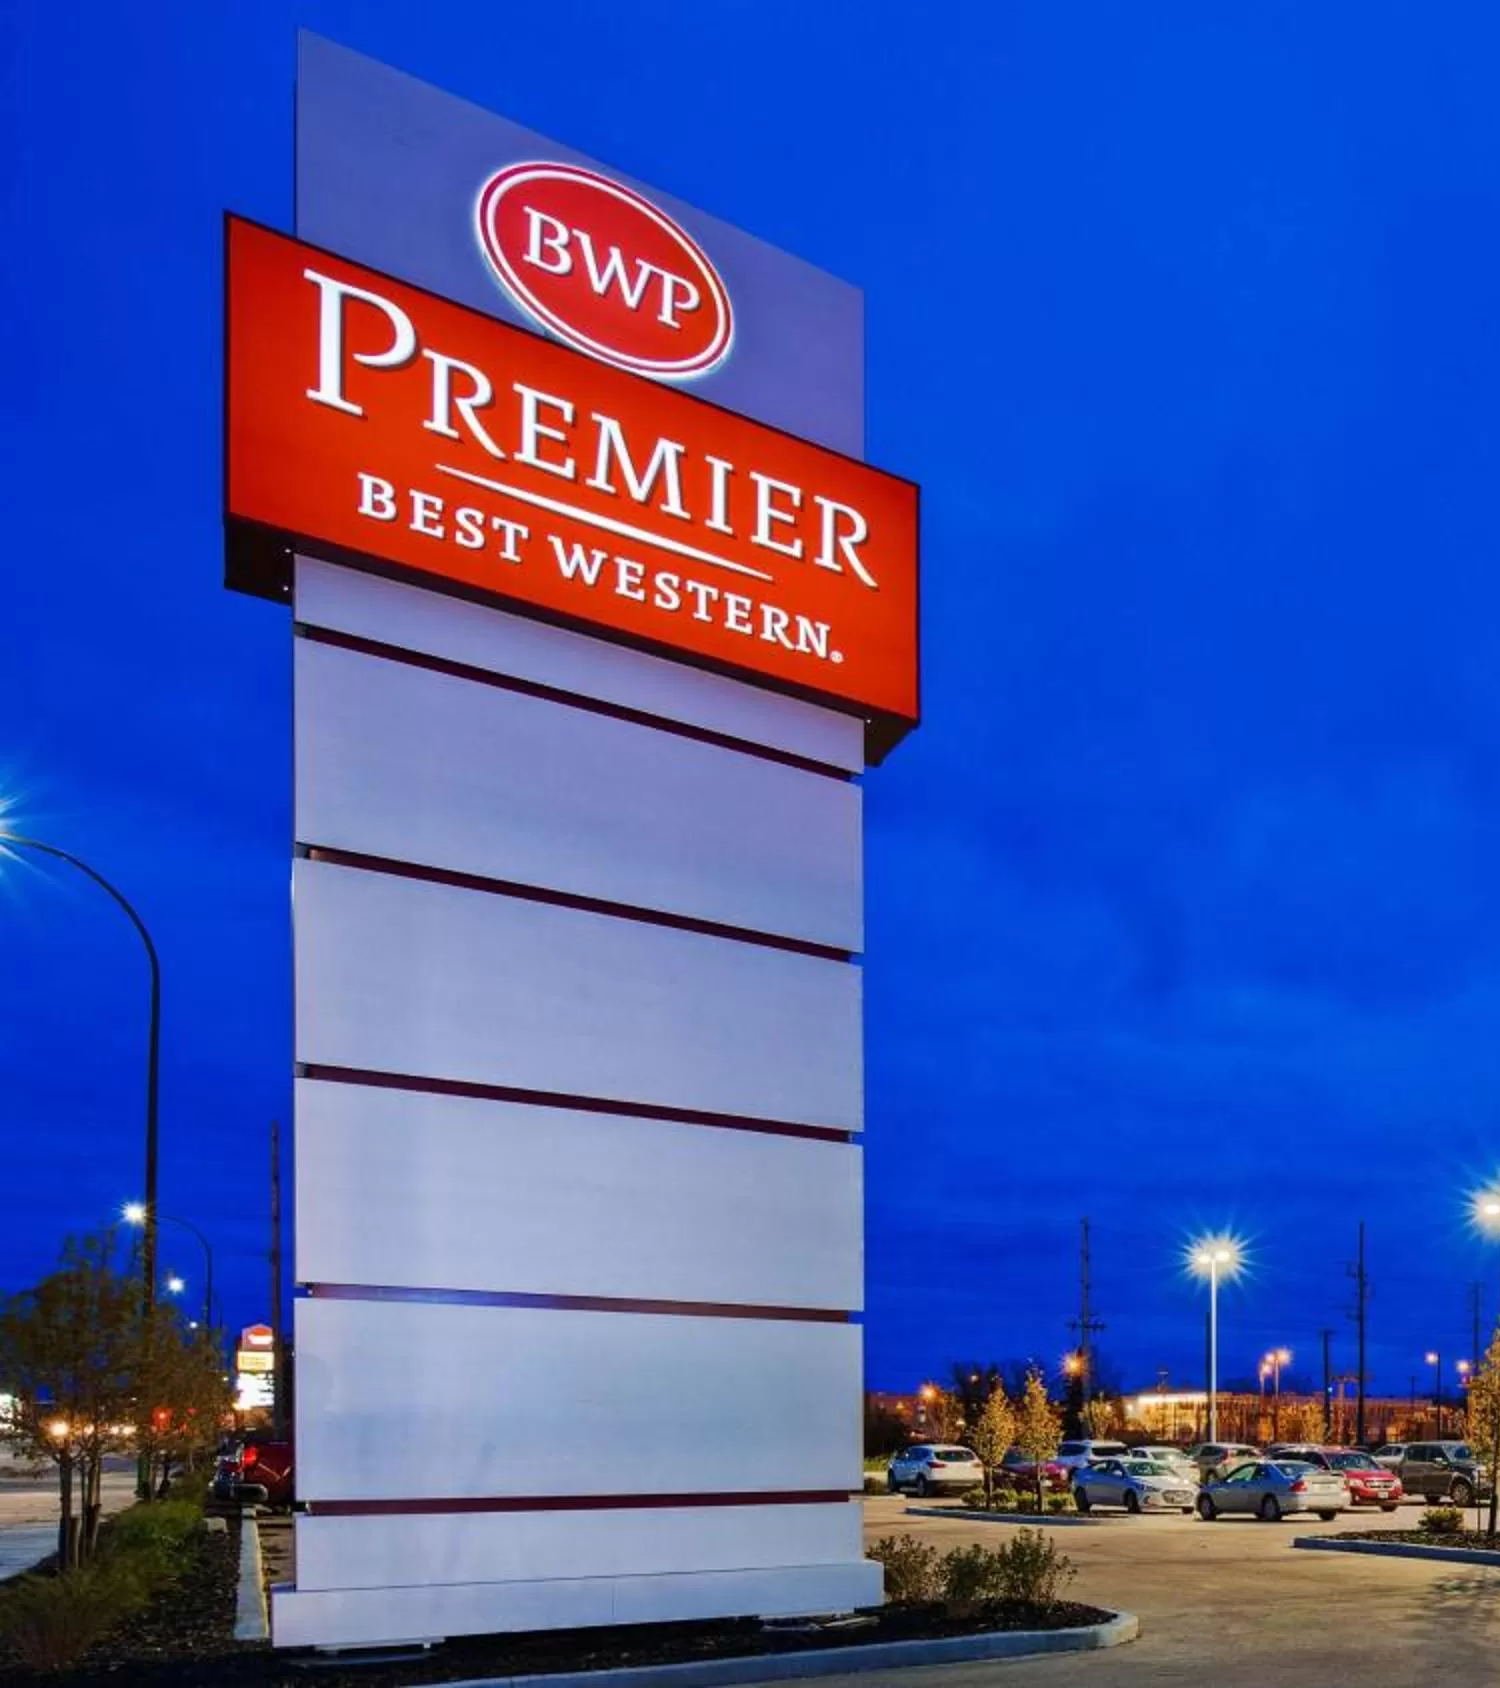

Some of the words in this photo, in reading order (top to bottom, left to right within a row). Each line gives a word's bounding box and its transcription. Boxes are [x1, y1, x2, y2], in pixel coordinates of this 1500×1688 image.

[523, 205, 700, 329] BWP
[303, 268, 879, 588] PREMIER
[357, 473, 529, 562] BEST
